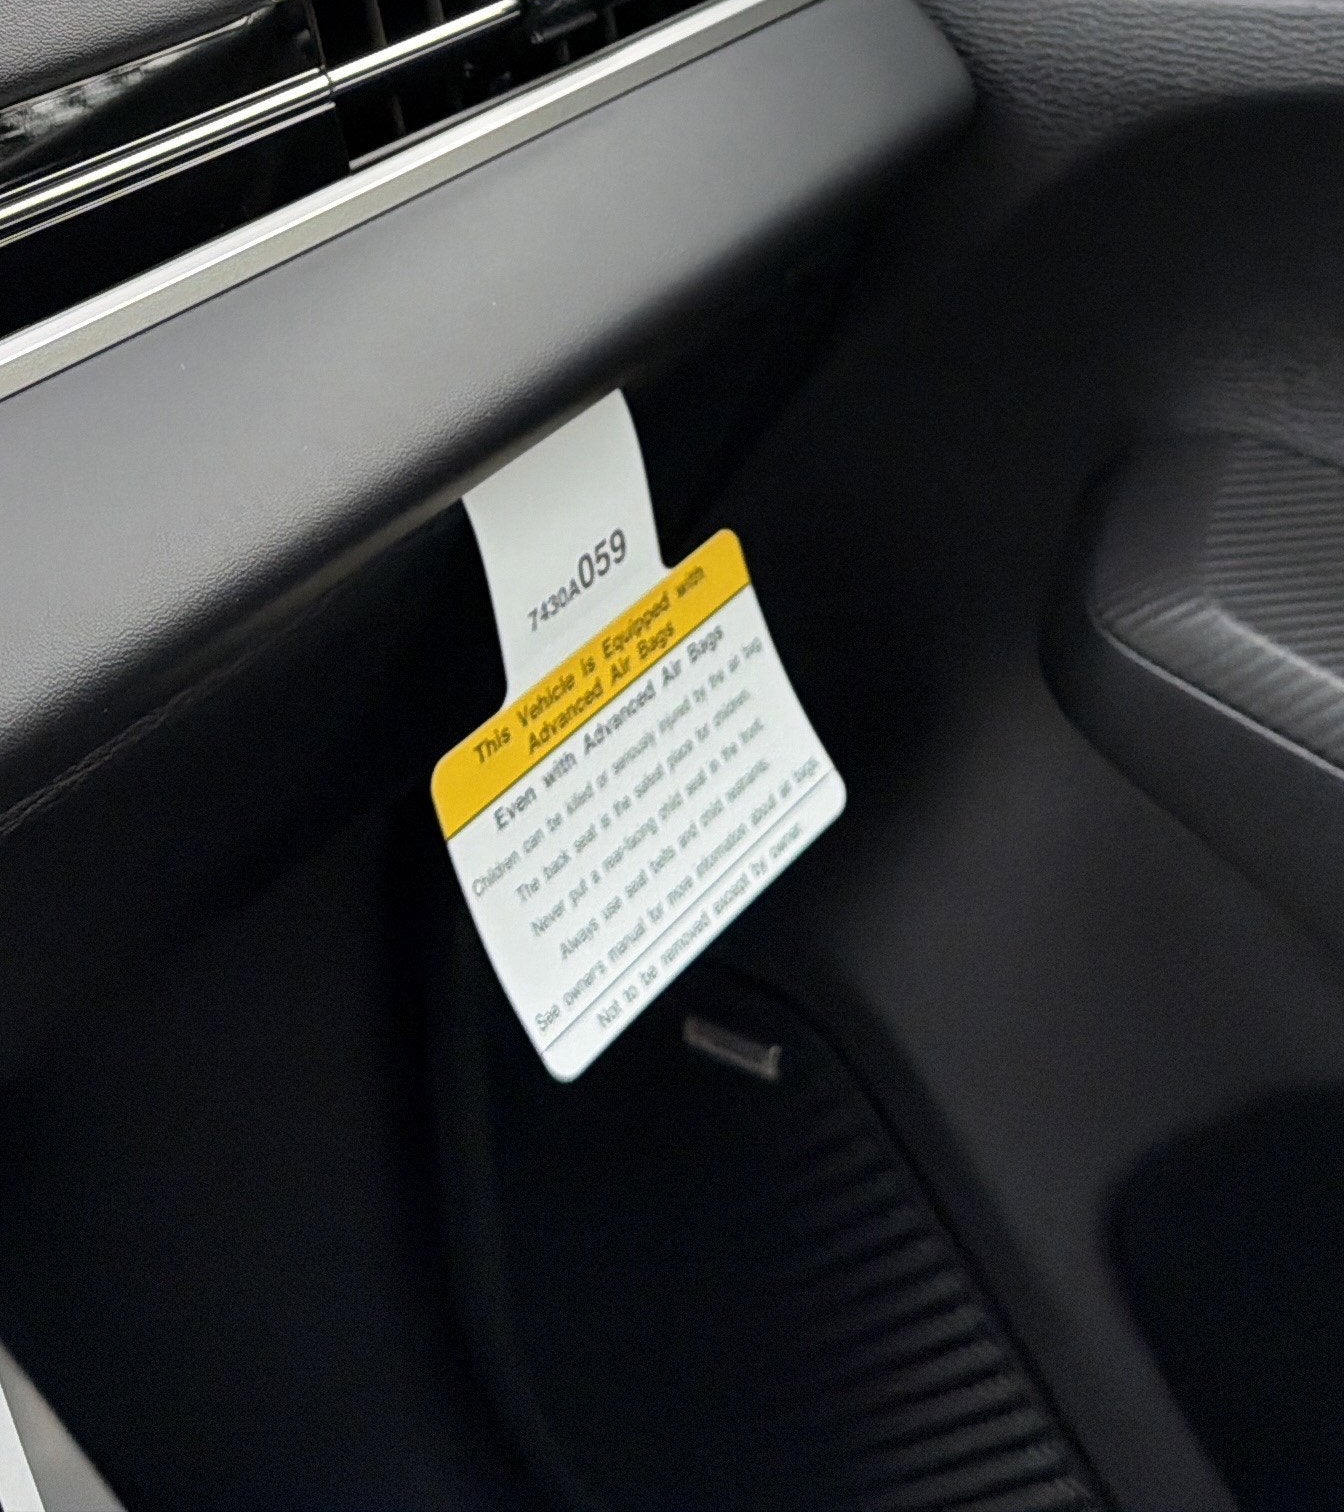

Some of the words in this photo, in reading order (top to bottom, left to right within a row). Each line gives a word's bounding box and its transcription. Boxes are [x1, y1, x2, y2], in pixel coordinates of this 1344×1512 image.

[473, 726, 511, 764] This
[516, 672, 575, 727] Vehicle
[601, 590, 671, 660] Equipped
[675, 565, 705, 599] with
[527, 528, 627, 632] 7430A059
[493, 786, 537, 831] Even
[542, 751, 578, 788] with
[582, 678, 657, 756] Advanced
[661, 658, 682, 687] Air
[686, 625, 724, 664] Bags
[528, 676, 604, 755] Advanced
[609, 654, 631, 685] Air
[637, 620, 675, 662] Bags
[472, 850, 520, 897] Children
[522, 828, 545, 854] can
[546, 811, 563, 833] be
[565, 781, 595, 815] killed
[596, 770, 609, 789] or
[612, 730, 657, 776] seriously
[692, 686, 707, 704] by
[708, 668, 725, 690] the
[515, 877, 541, 902] The
[543, 849, 571, 881] back
[573, 822, 599, 853] seat
[600, 812, 612, 830] is
[612, 794, 632, 818] the
[667, 738, 694, 775] place
[694, 722, 710, 742] for
[529, 898, 565, 938] Never
[568, 877, 589, 908] put
[591, 869, 601, 886] a
[602, 815, 658, 872] rear-facing
[658, 789, 684, 822] child
[685, 767, 708, 797] seat
[720, 740, 738, 763] the
[535, 1004, 561, 1032] See
[607, 915, 647, 963] manual
[647, 900, 665, 925] for
[667, 874, 694, 906] more
[696, 821, 748, 879] information
[750, 792, 778, 826] about
[559, 917, 600, 962] Always
[601, 894, 624, 922] use
[625, 868, 649, 900] seat
[650, 844, 677, 875] belts
[677, 821, 700, 849] and
[700, 797, 725, 829] child
[596, 998, 623, 1029] Not
[623, 984, 639, 1004] to
[639, 964, 659, 987] be
[660, 910, 712, 968] removed
[713, 871, 751, 916] except
[750, 857, 769, 878] by
